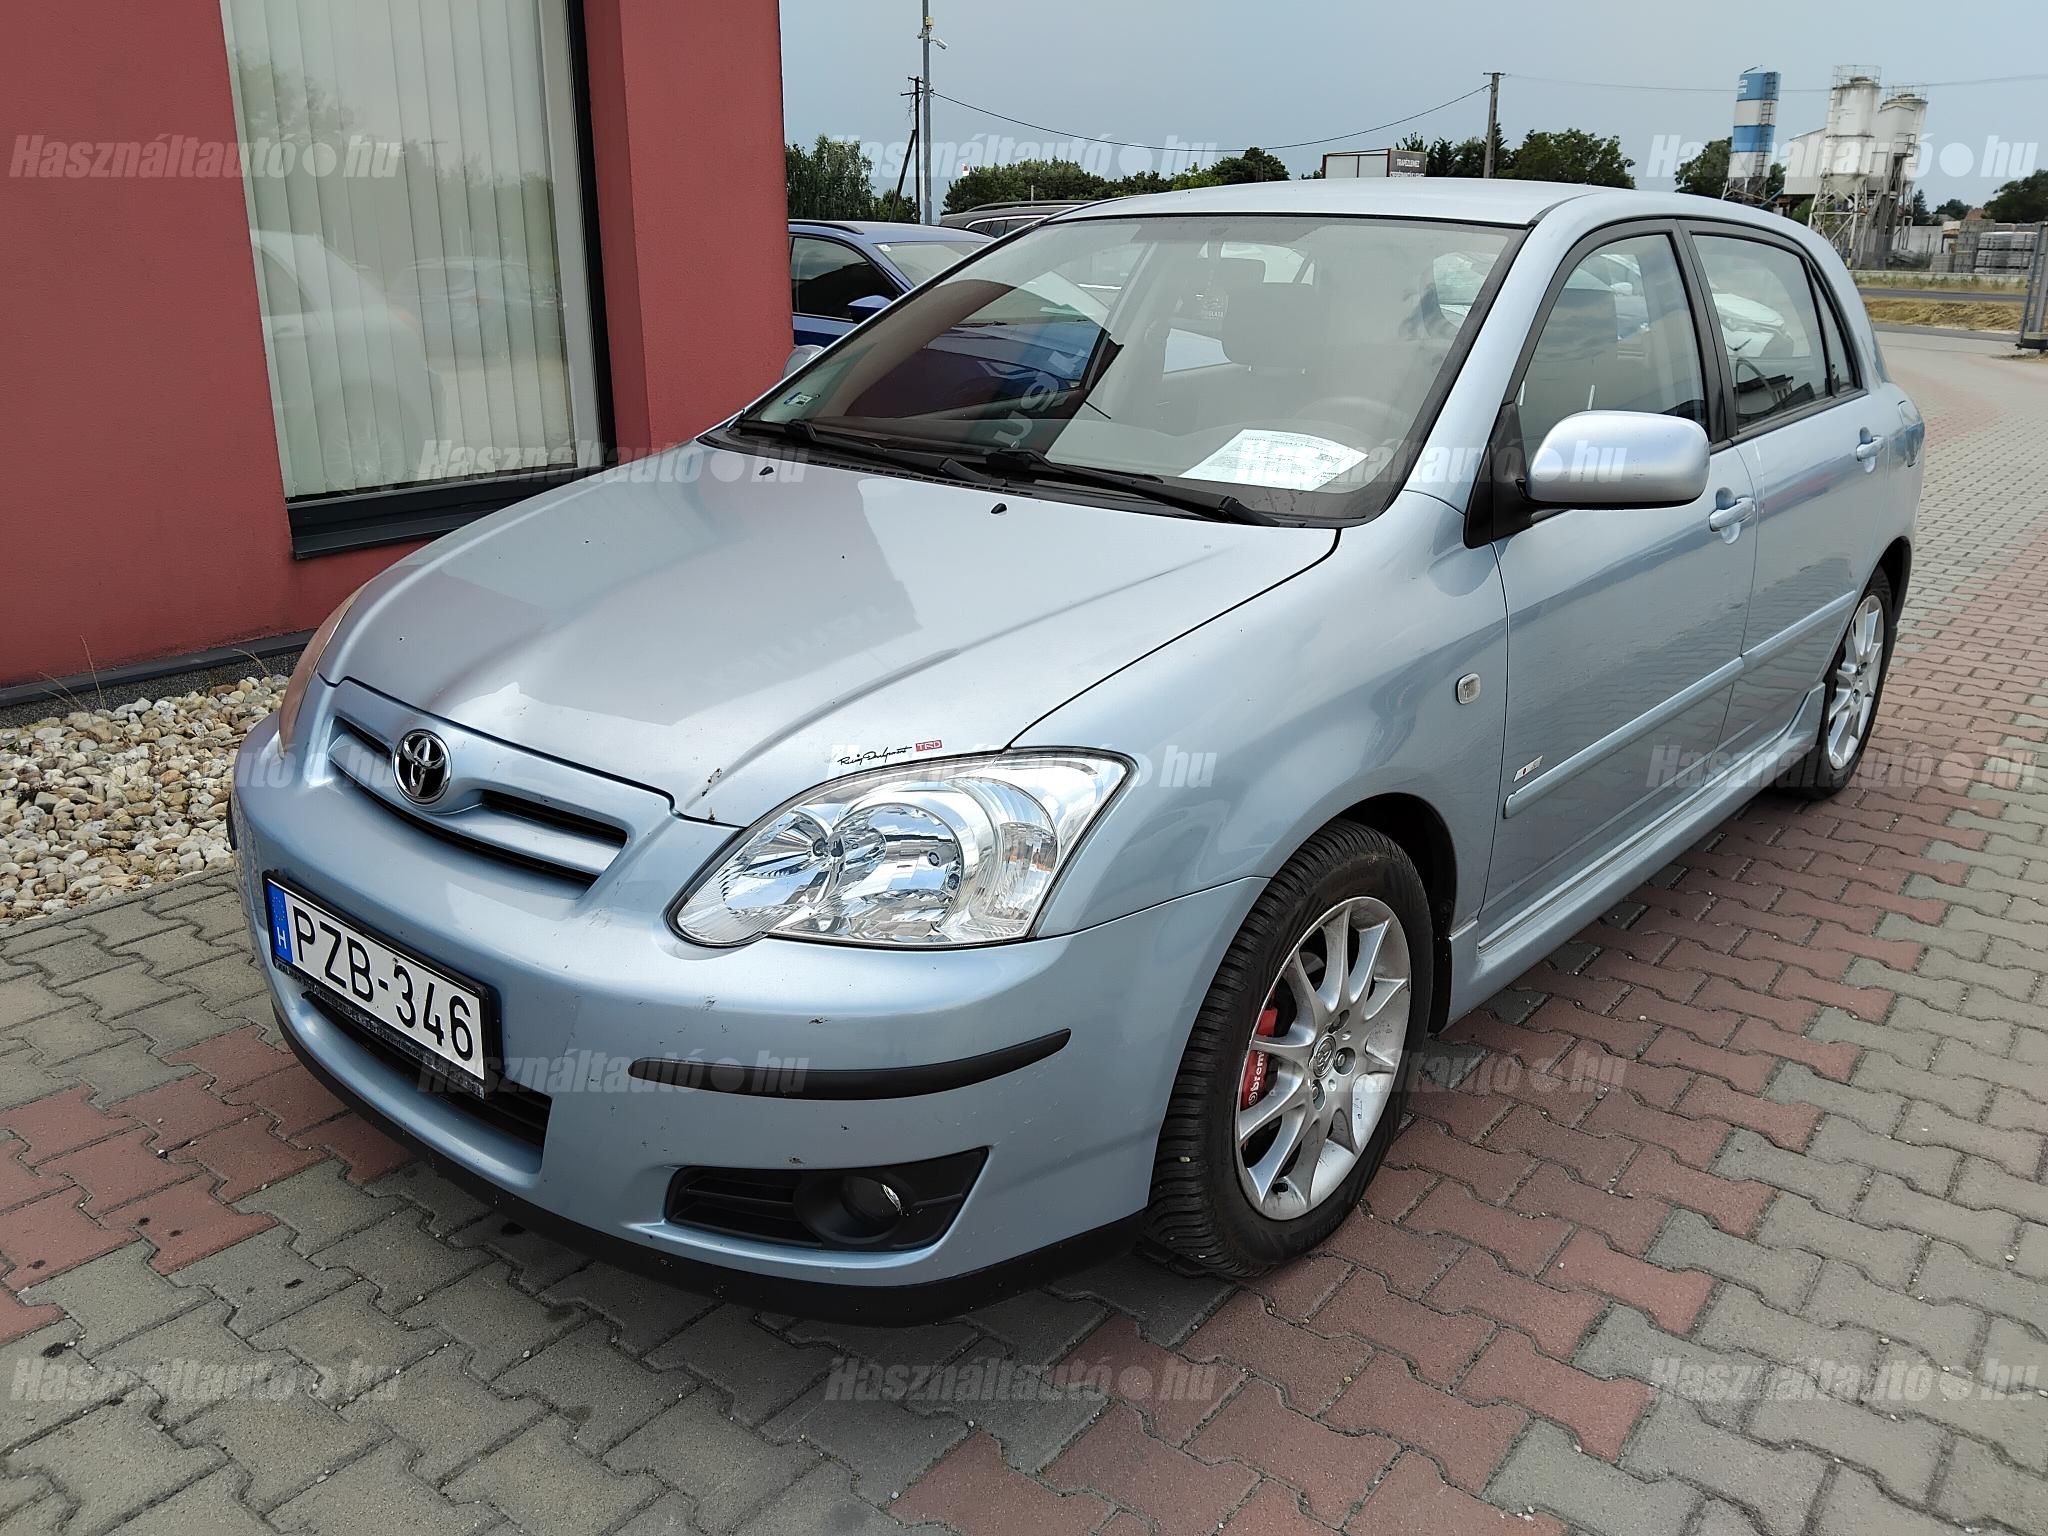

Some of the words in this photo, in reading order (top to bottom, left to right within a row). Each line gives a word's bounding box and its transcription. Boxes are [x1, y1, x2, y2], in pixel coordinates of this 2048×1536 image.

[916, 740, 942, 752] TRD
[276, 925, 287, 951] H
[292, 905, 474, 1062] PZB-346
